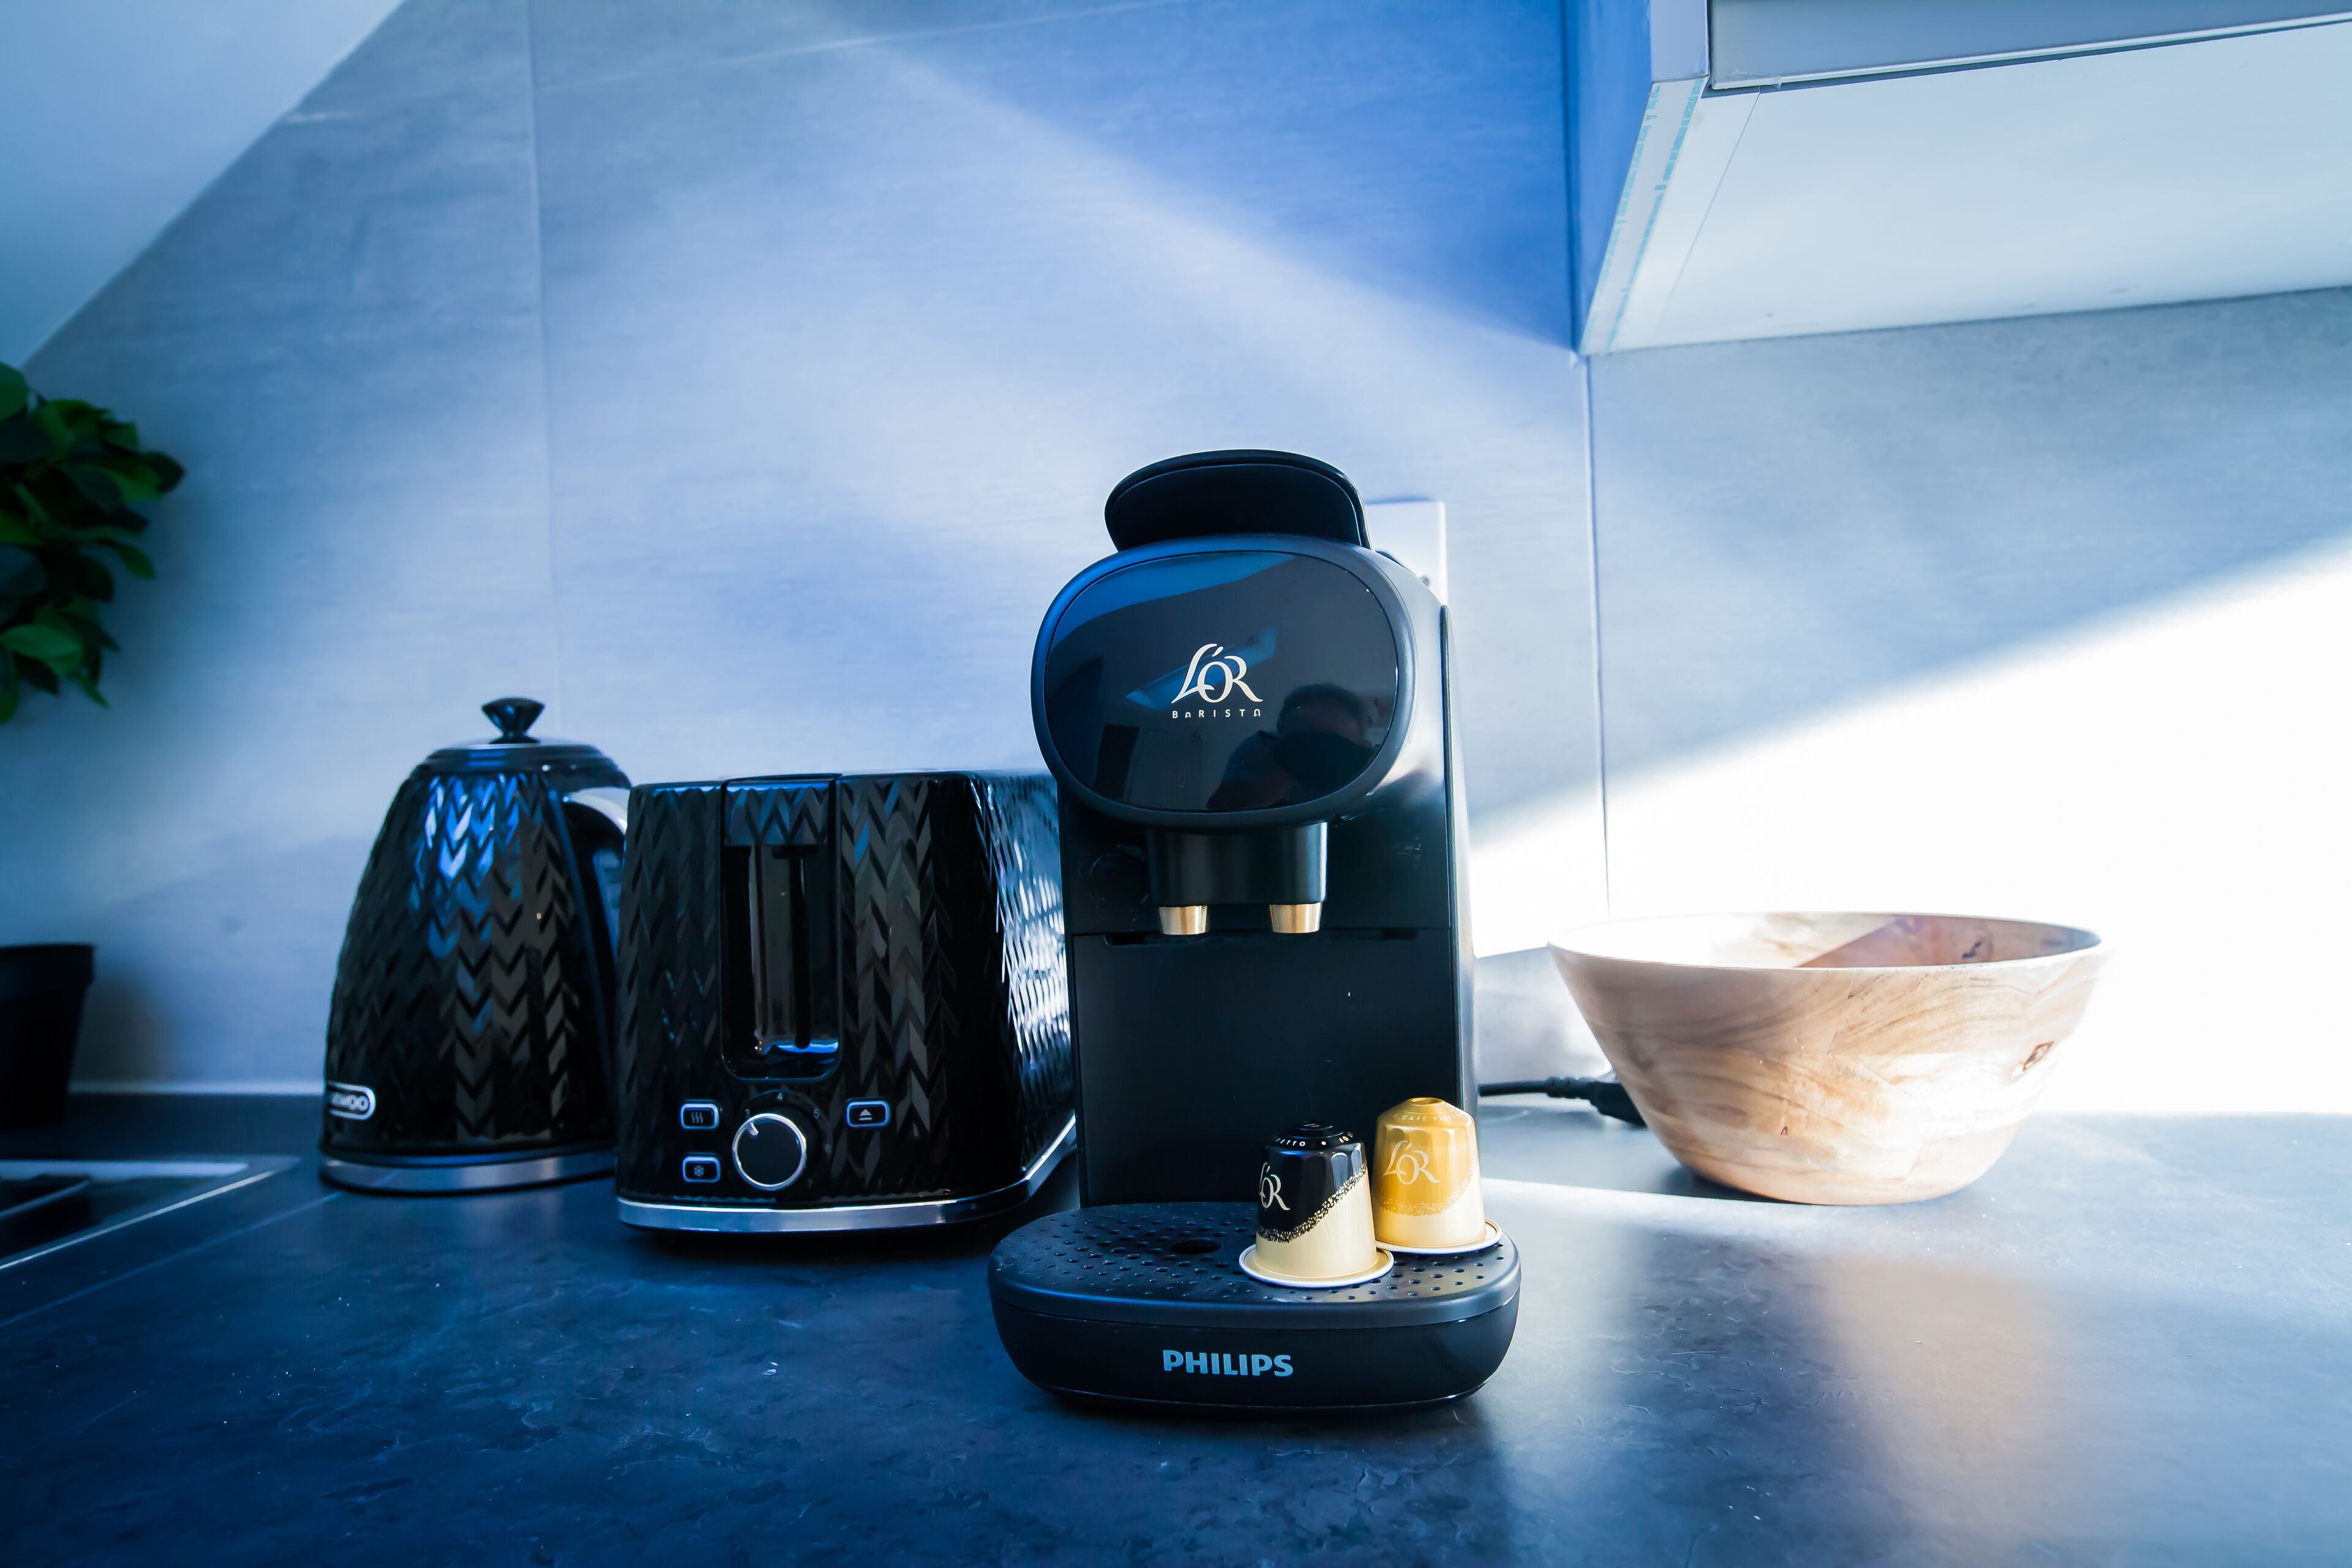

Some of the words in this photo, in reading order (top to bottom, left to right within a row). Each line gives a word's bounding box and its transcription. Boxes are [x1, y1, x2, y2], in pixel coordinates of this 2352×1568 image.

[1171, 643, 1264, 704] L'OR
[1383, 1140, 1441, 1185] L'OR
[1259, 1162, 1291, 1210] L'OR
[1163, 1349, 1294, 1377] PHILIPS
